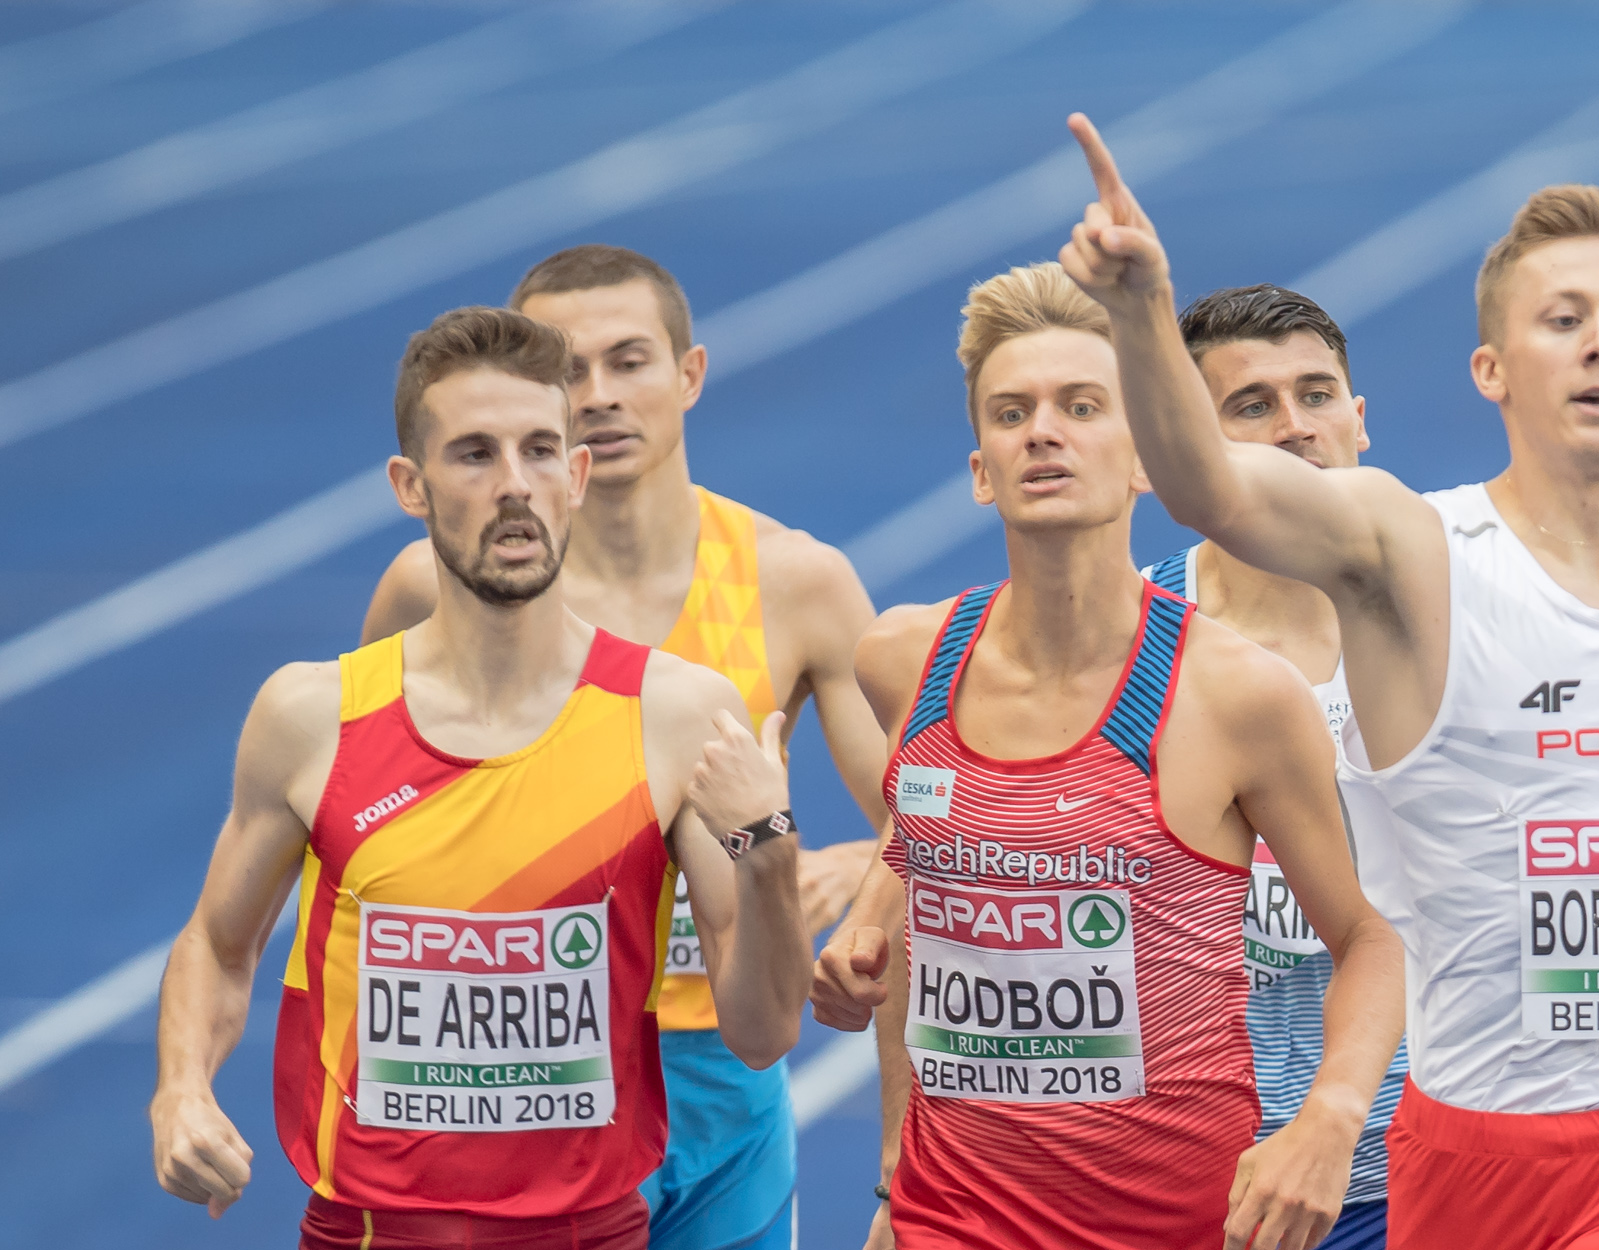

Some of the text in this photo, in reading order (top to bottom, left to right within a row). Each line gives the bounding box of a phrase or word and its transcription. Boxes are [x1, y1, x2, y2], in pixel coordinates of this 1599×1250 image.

[902, 779, 933, 796] ČESKÁ
[914, 893, 1060, 943] SPAR
[370, 920, 541, 967] SPAR
[1255, 944, 1295, 967] RUN
[368, 978, 601, 1050] DE ARRIBA
[917, 965, 1125, 1031] HODBOĎ
[958, 1036, 998, 1054] RUN
[424, 1065, 473, 1083] RUN
[921, 1058, 1122, 1095] BERLIN 2018
[384, 1091, 596, 1125] BERLIN 2018
